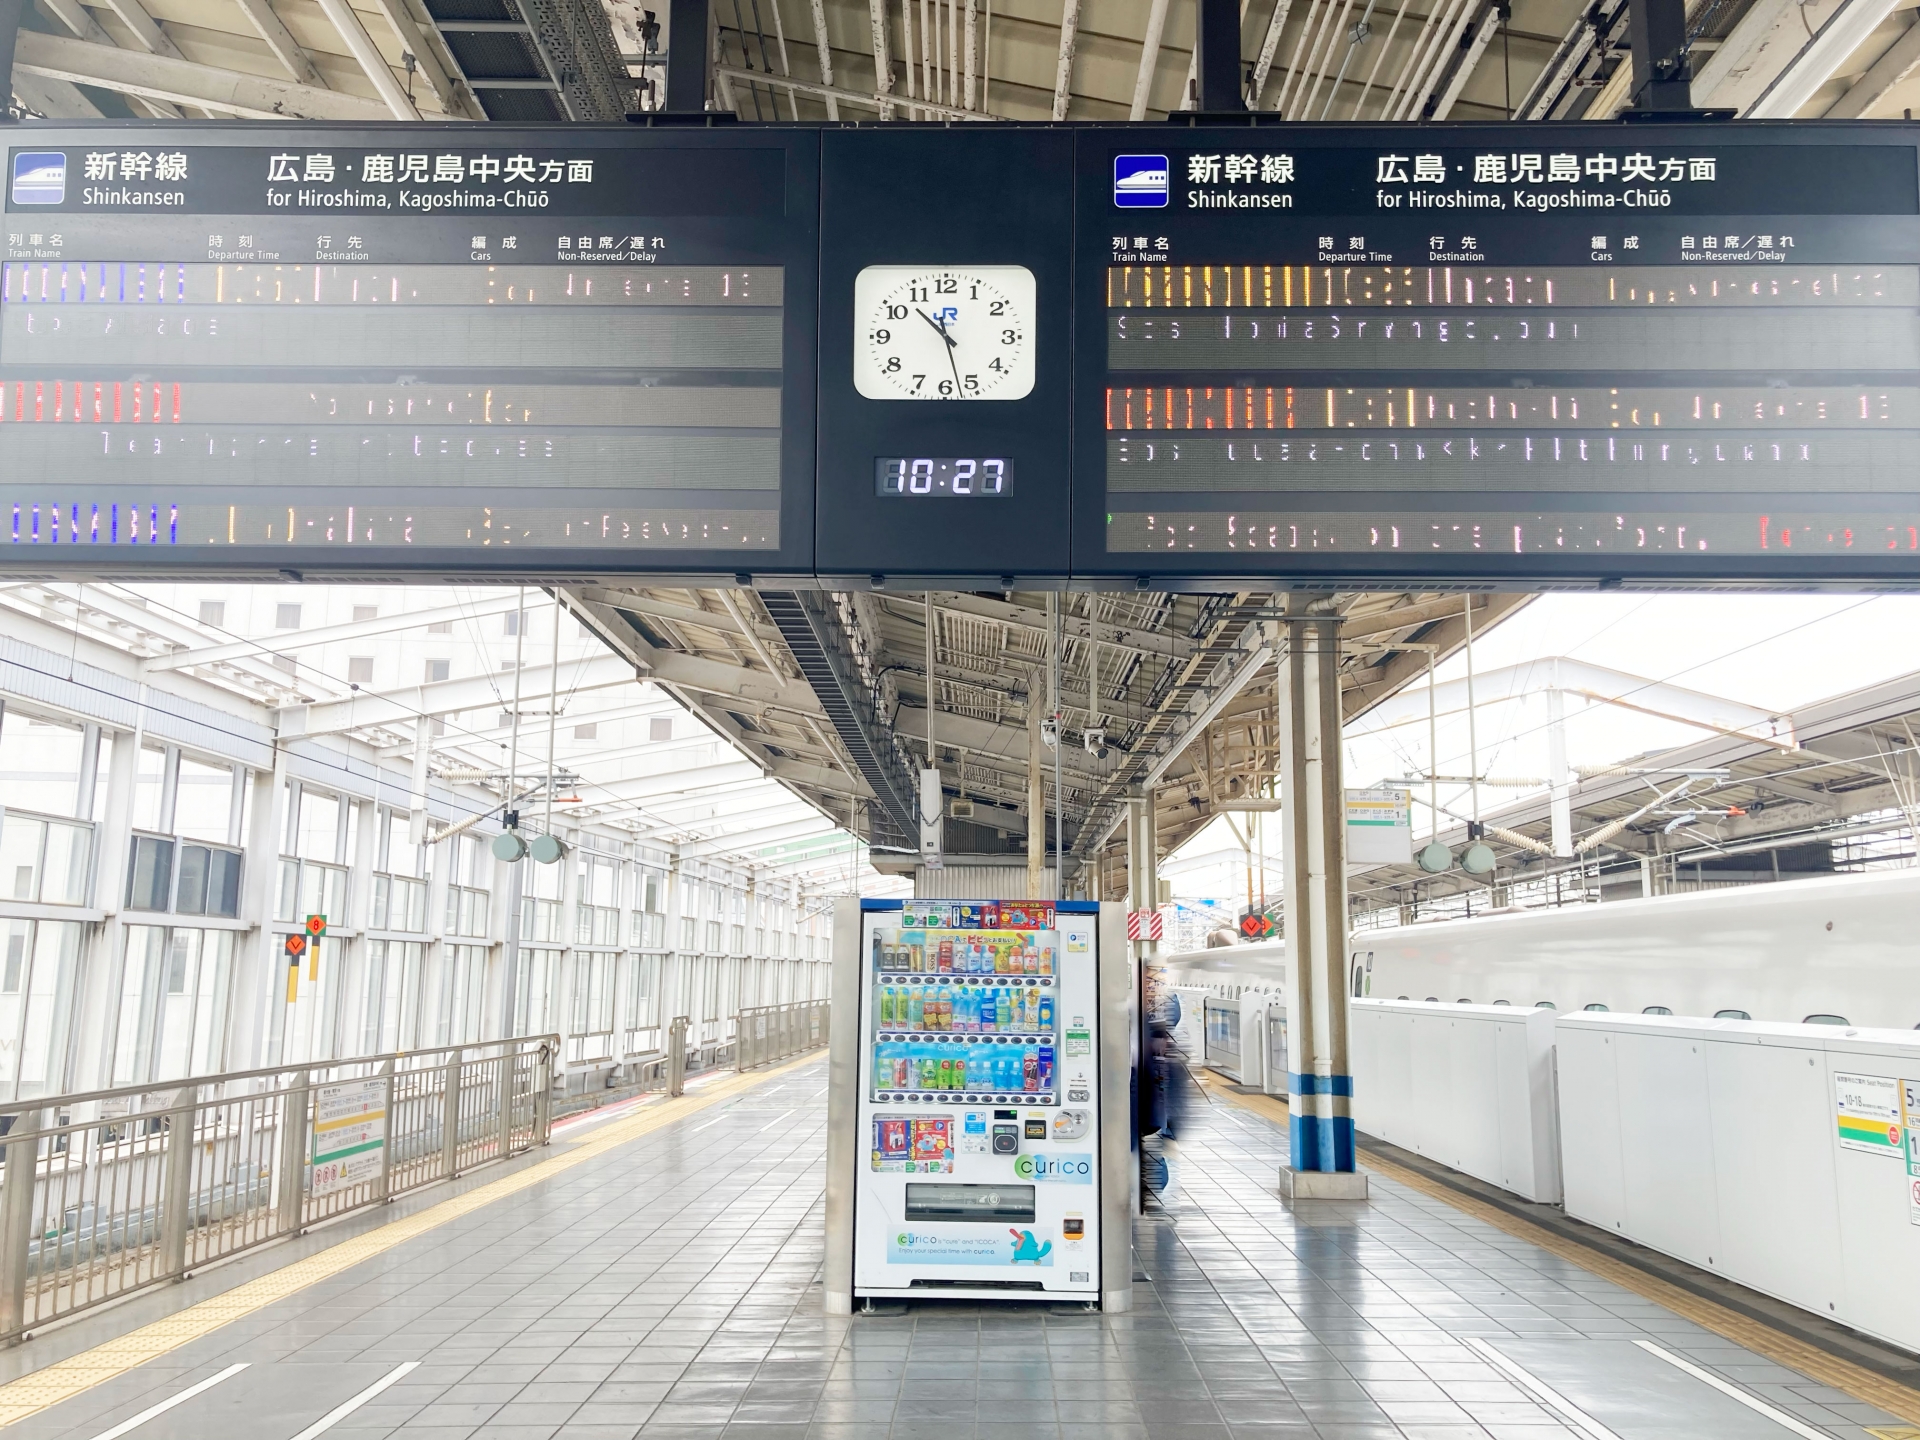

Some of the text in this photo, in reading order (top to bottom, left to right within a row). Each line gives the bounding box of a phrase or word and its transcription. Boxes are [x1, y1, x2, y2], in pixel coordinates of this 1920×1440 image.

[83, 151, 188, 181] 新幹線
[266, 152, 594, 184] 広島・鹿児島中央方面
[1187, 153, 1295, 184] 新幹線
[1376, 152, 1717, 184] 広島・鹿児島中央方面
[83, 186, 185, 206] Shinkansen
[266, 187, 550, 211] for Hiroshima, Kagoshima-Chūō
[1188, 189, 1293, 209] Shinkansen
[1376, 188, 1672, 212] for Hiroshima, Kagoshima-Chūō
[8, 233, 64, 247] 列車名
[208, 234, 254, 248] 時刻
[316, 235, 363, 249] 行先
[471, 235, 517, 250] 編成
[1112, 236, 1170, 251] 列車名
[1318, 236, 1365, 250] 時刻
[1429, 236, 1477, 250] 行先
[1591, 235, 1640, 250] 編成
[8, 248, 62, 258] Train Name
[208, 249, 280, 262] Departure Time
[316, 250, 369, 261] Destination
[470, 251, 492, 261] Cars
[557, 250, 657, 264] Non-Reserved/Delay
[1112, 251, 1168, 262] Train Name
[1318, 251, 1393, 264] Departure Time
[1429, 251, 1485, 262] Destination
[1591, 251, 1613, 261] Cars
[1681, 250, 1787, 263] Non-Reserved/Delay
[934, 279, 958, 294] 12
[969, 285, 979, 300] 1
[909, 287, 930, 303] 11
[886, 304, 909, 320] 10
[933, 307, 958, 321] JR
[989, 301, 1004, 316] 2
[875, 329, 891, 345] 9
[1001, 329, 1016, 345] 3
[886, 356, 902, 372] 8
[988, 357, 1004, 372] 4
[912, 374, 927, 390] 7
[938, 379, 953, 395] 6
[963, 373, 979, 390] 5
[897, 458, 1005, 494] 10:27
[1845, 1094, 1863, 1107] 10-18
[1906, 1088, 1915, 1107] 5
[1911, 1136, 1918, 1156] 1
[1021, 1158, 1089, 1175] curico
[900, 1235, 937, 1244] curico
